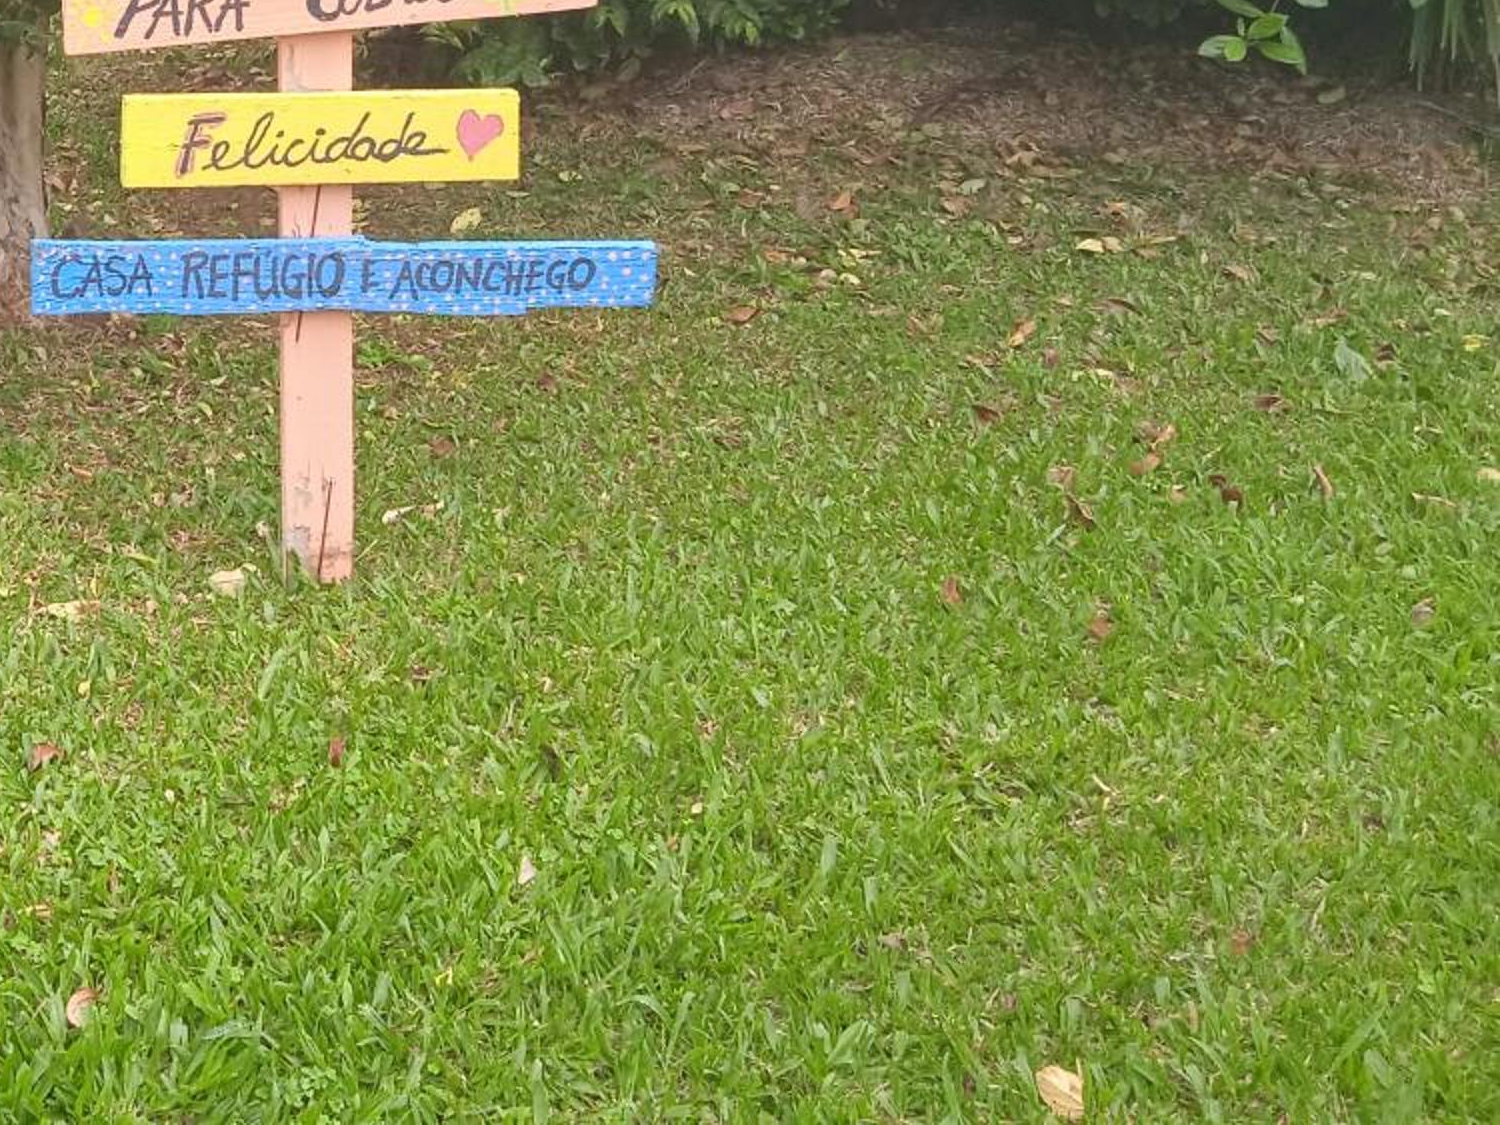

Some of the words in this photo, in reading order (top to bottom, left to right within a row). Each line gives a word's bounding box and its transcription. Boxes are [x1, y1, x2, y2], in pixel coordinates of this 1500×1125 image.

[175, 111, 448, 178] Felicidade
[50, 254, 153, 301] CASA
[360, 257, 389, 293] E
[391, 257, 598, 300] ACONCHEGO
